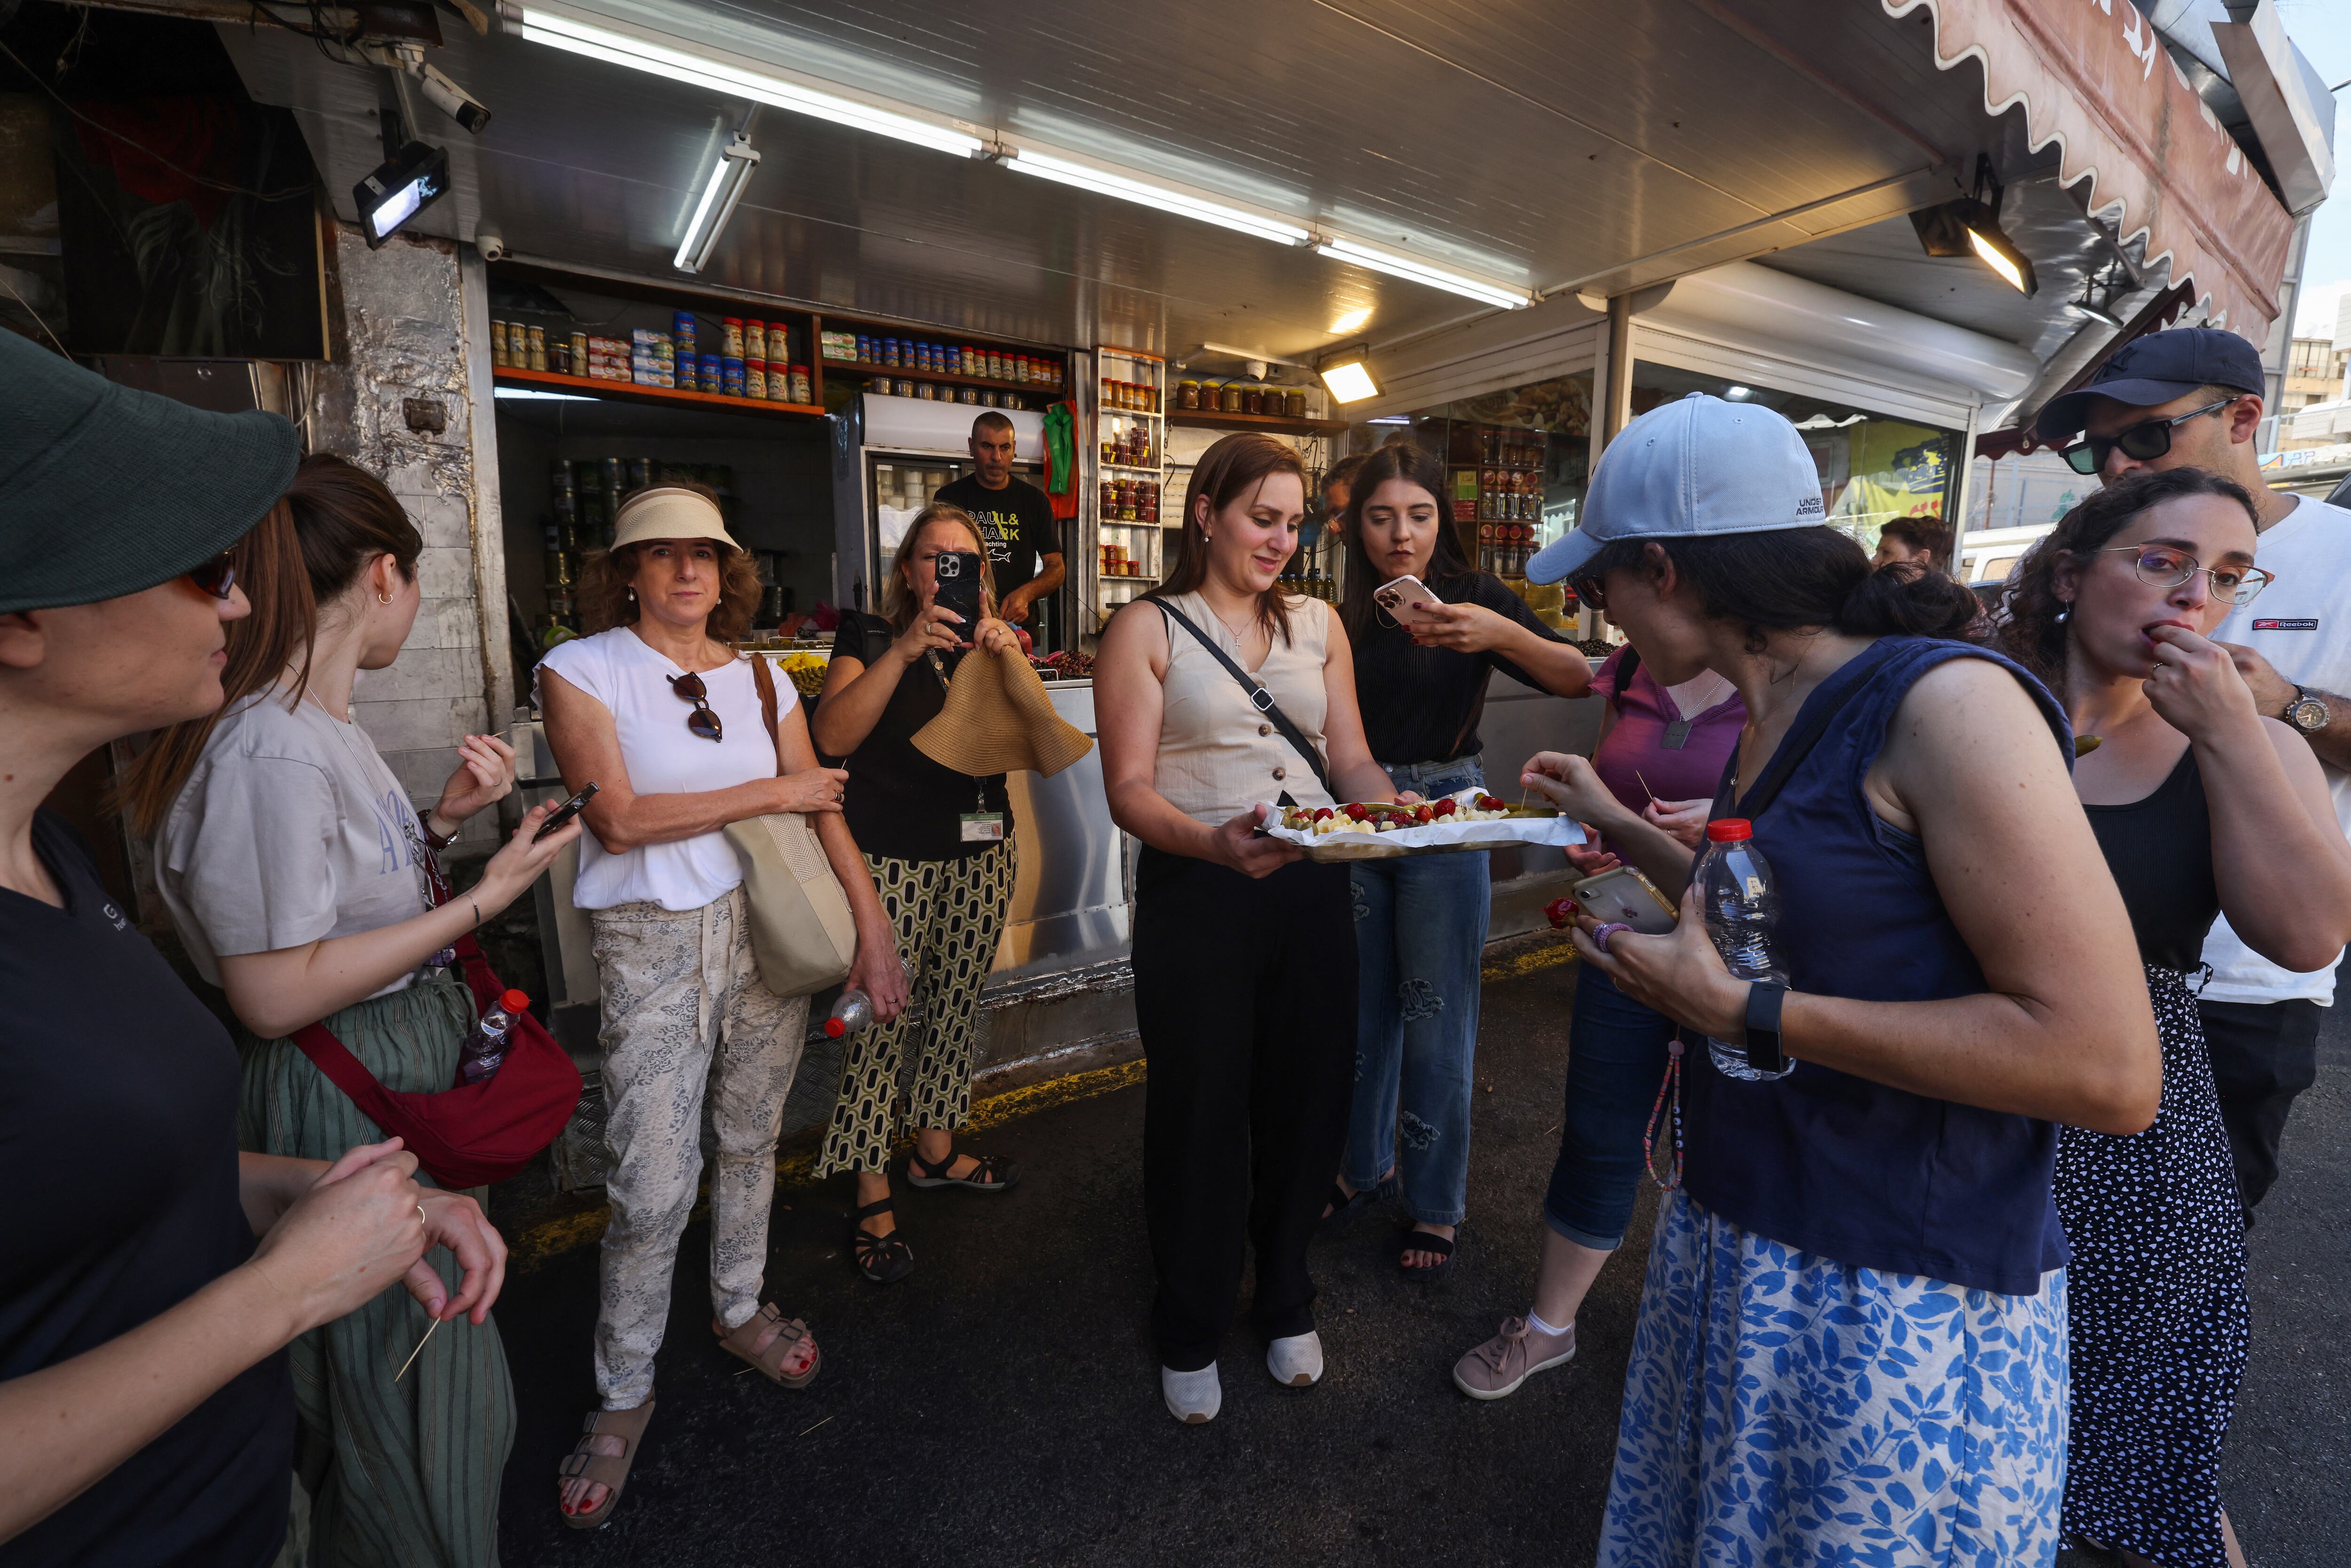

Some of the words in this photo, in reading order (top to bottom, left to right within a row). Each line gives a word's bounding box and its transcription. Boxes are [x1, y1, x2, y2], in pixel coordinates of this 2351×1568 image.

[1799, 498, 1822, 507] UNDER
[1796, 506, 1824, 516] ARMOUR
[979, 527, 1020, 541] HARK
